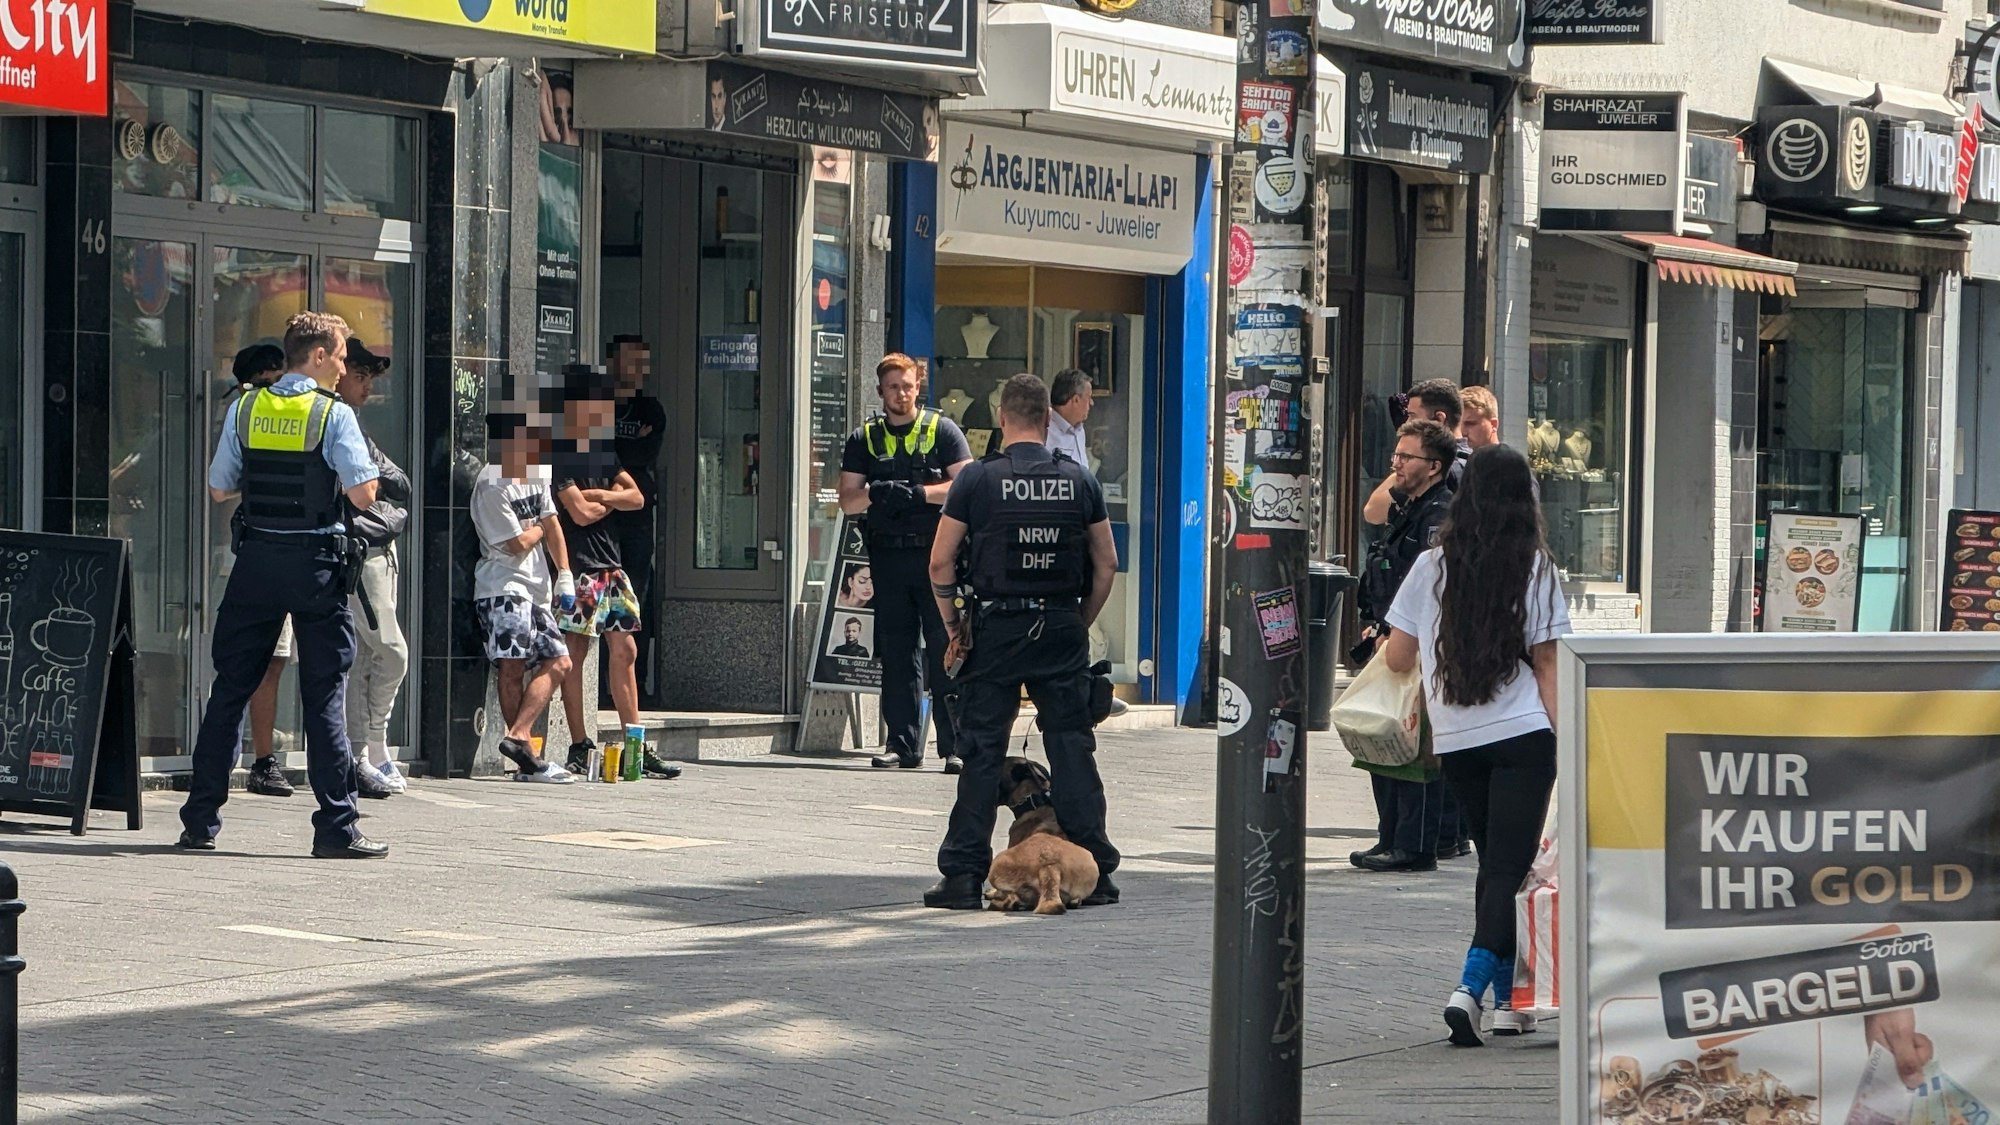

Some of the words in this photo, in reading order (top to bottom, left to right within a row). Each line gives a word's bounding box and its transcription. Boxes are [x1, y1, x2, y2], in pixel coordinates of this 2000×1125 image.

[829, 3, 924, 30] FRISEUR
[1531, 25, 1563, 34] ABEND
[1565, 25, 1573, 33] &
[1575, 24, 1640, 34] BRAUTMODEN
[1393, 16, 1424, 39] ABEND
[1426, 23, 1433, 40] &
[1434, 25, 1493, 54] BRAUTMODEN
[0, 55, 36, 89] ffnet
[1063, 47, 1136, 102] UHREN
[1141, 58, 1233, 125] Lennartz
[1388, 79, 1489, 139] Änderungsschneiderei
[1552, 98, 1646, 113] SHAHRAZAT
[766, 115, 814, 140] HERZLICH
[818, 125, 882, 149] WILLKOMMEN
[1597, 113, 1658, 125] JUWELIER
[1410, 131, 1419, 155] &
[1421, 132, 1463, 164] Boutique
[1902, 120, 1956, 195] DÖNER
[1551, 155, 1578, 169] IHR
[980, 144, 1178, 211] ARGJENTARIA-LLAPI
[1551, 172, 1667, 188] GOLDSCHMIED
[915, 214, 929, 239] 42
[1004, 199, 1080, 232] Kuyumcu
[1097, 210, 1161, 240] Juwelier
[82, 218, 106, 254] 46
[547, 249, 557, 262] Mit
[557, 251, 570, 263] und
[539, 264, 556, 278] Ohne
[556, 266, 577, 280] Termin
[1247, 313, 1286, 324] HELLO
[703, 353, 759, 365] freihalten
[709, 339, 758, 353] Eingang
[253, 416, 303, 436] POLIZEI
[1001, 479, 1075, 501] POLIZEI
[1018, 528, 1060, 544] NRW
[1022, 552, 1056, 569] DHF
[22, 665, 76, 694] Caffe
[1700, 751, 1810, 797] WIR
[1700, 808, 1928, 853] KAUFEN
[1700, 865, 1796, 910] IHR
[1810, 864, 1974, 906] GOLD
[1859, 935, 1935, 961] Sofort
[1682, 959, 1927, 1033] BARGELD
